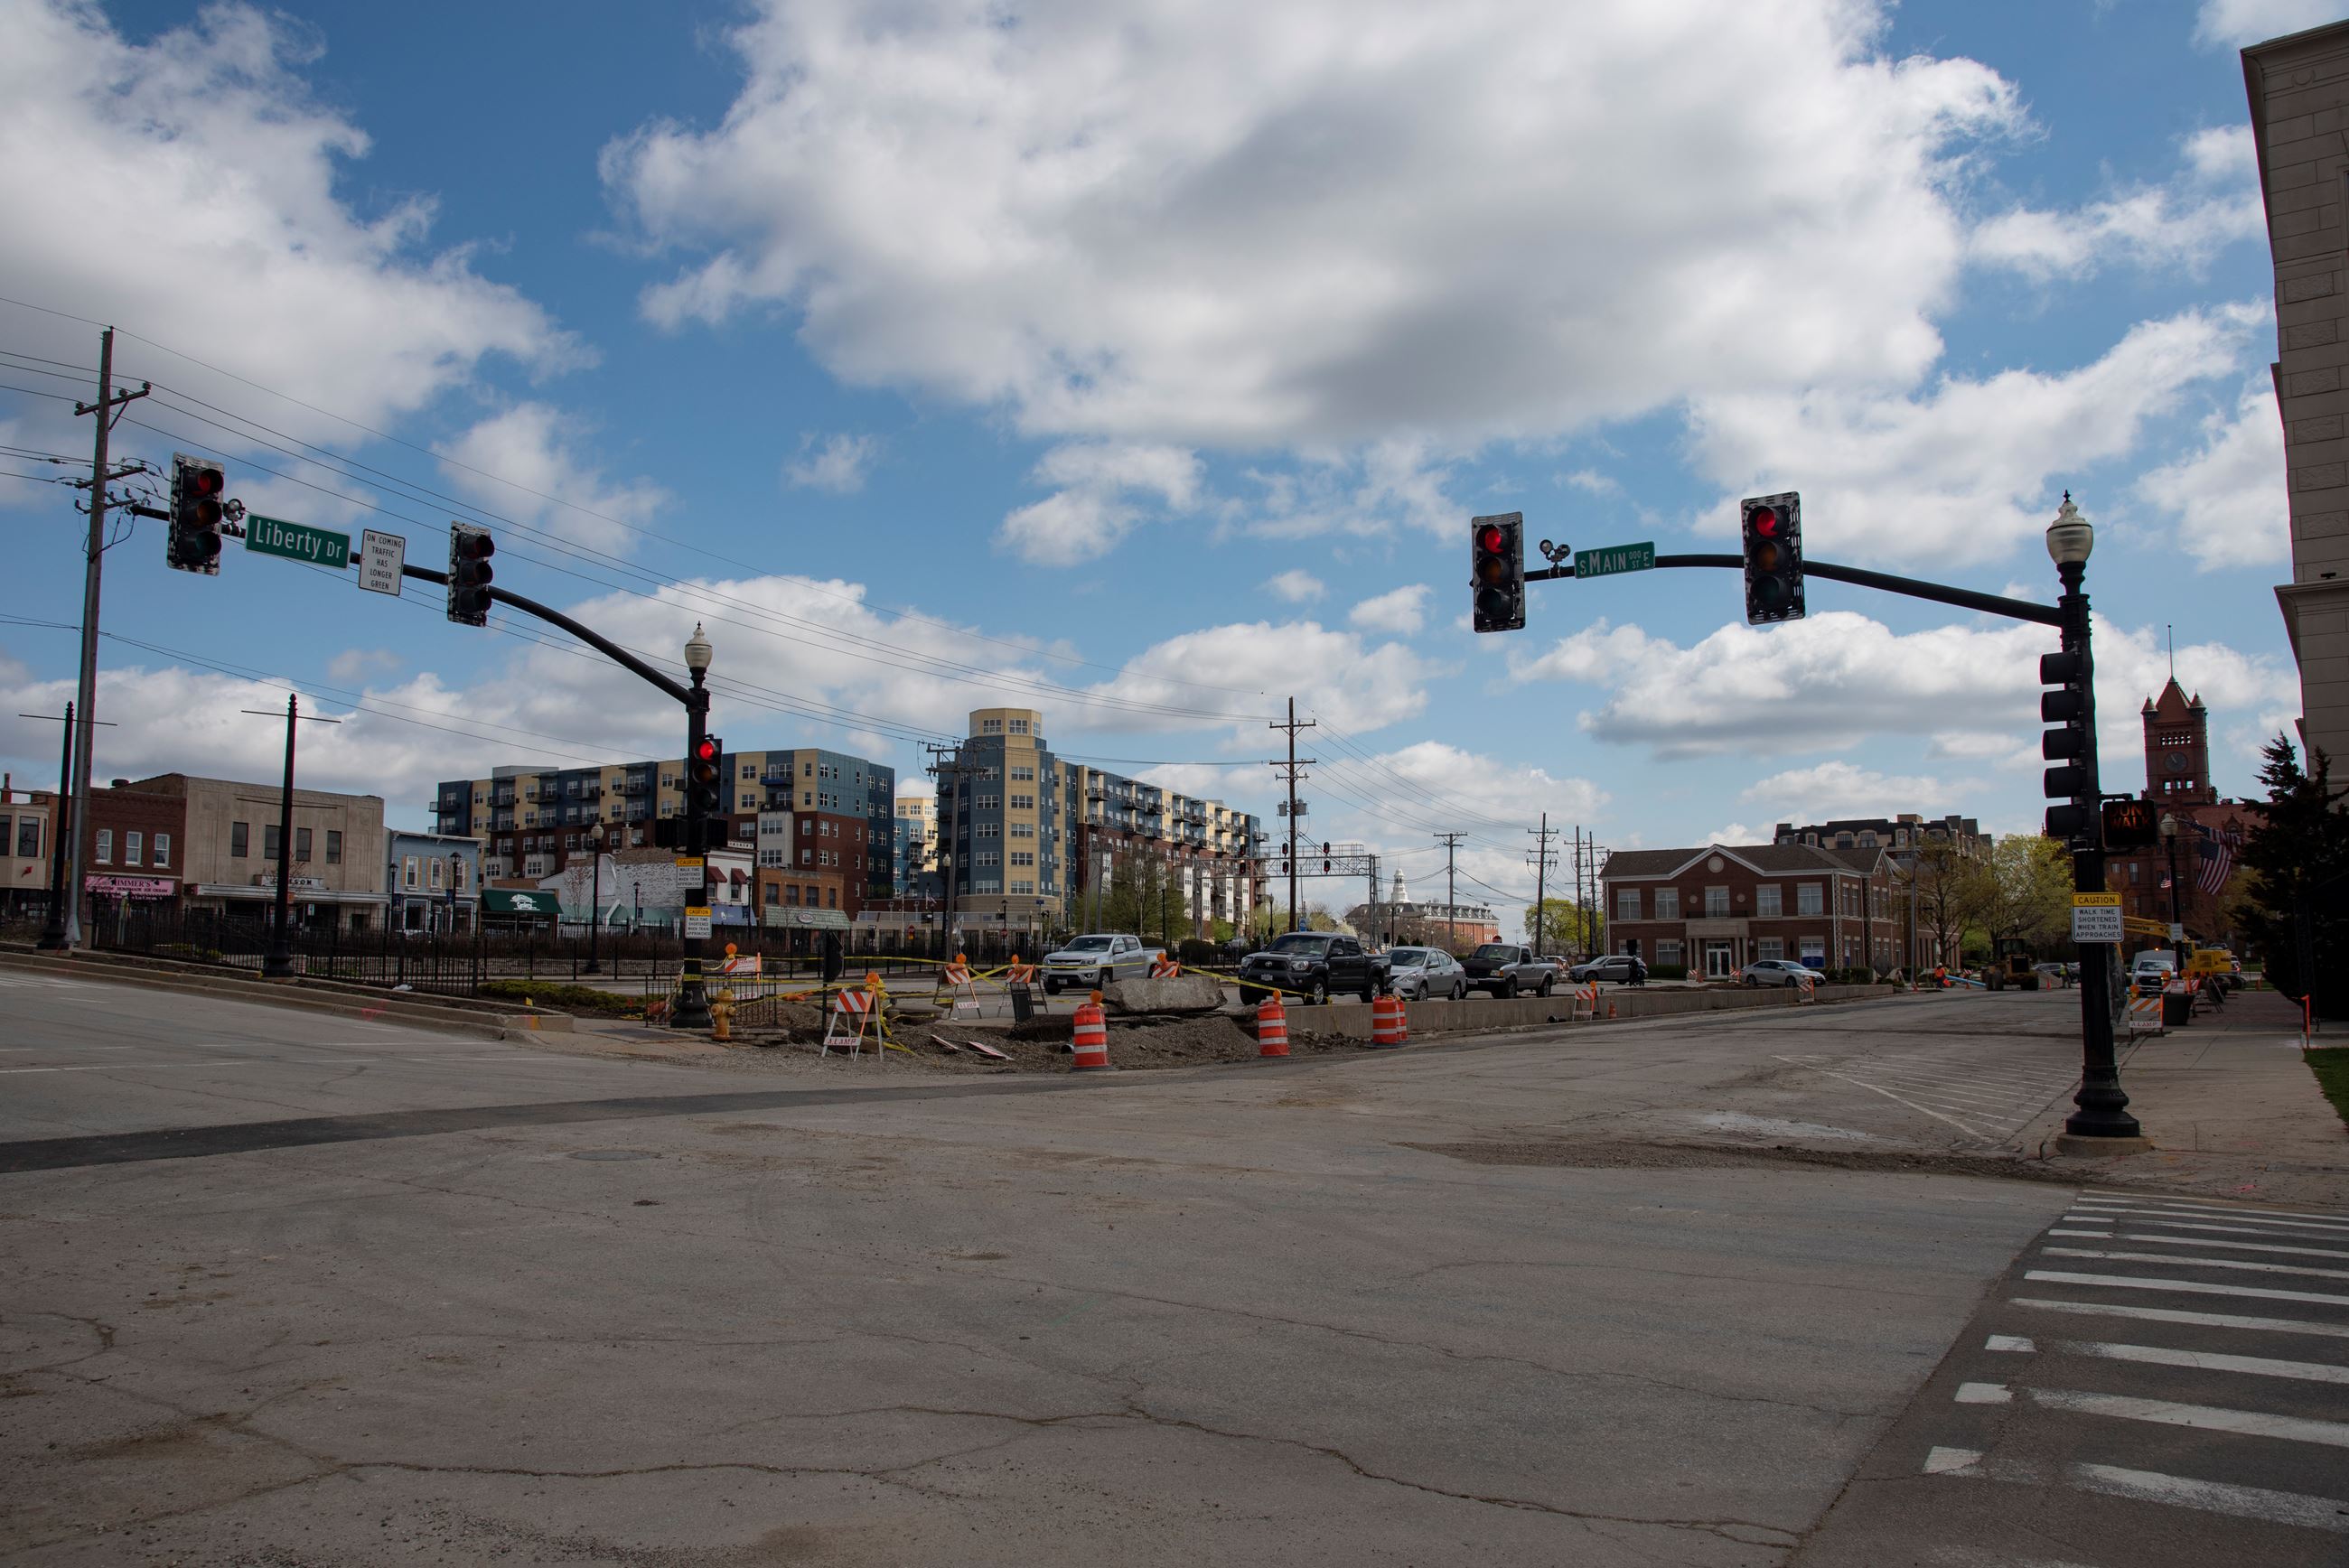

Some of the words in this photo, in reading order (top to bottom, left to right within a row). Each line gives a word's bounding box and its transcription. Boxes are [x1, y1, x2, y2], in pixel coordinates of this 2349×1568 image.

[256, 519, 322, 560] Liberty
[326, 541, 342, 559] Dr
[367, 534, 376, 542] ON
[379, 536, 403, 548] COMING
[372, 546, 395, 558] TRAFFIC
[377, 558, 388, 568] HAS
[1589, 551, 1627, 574] MAIN
[1632, 560, 1640, 569] ST
[1642, 551, 1651, 567] E
[370, 569, 393, 580] LONGER
[371, 580, 389, 590] GREEN
[2110, 817, 2152, 831] WALK
[113, 879, 151, 887] IMMER'S
[2078, 896, 2115, 904] CAUTION
